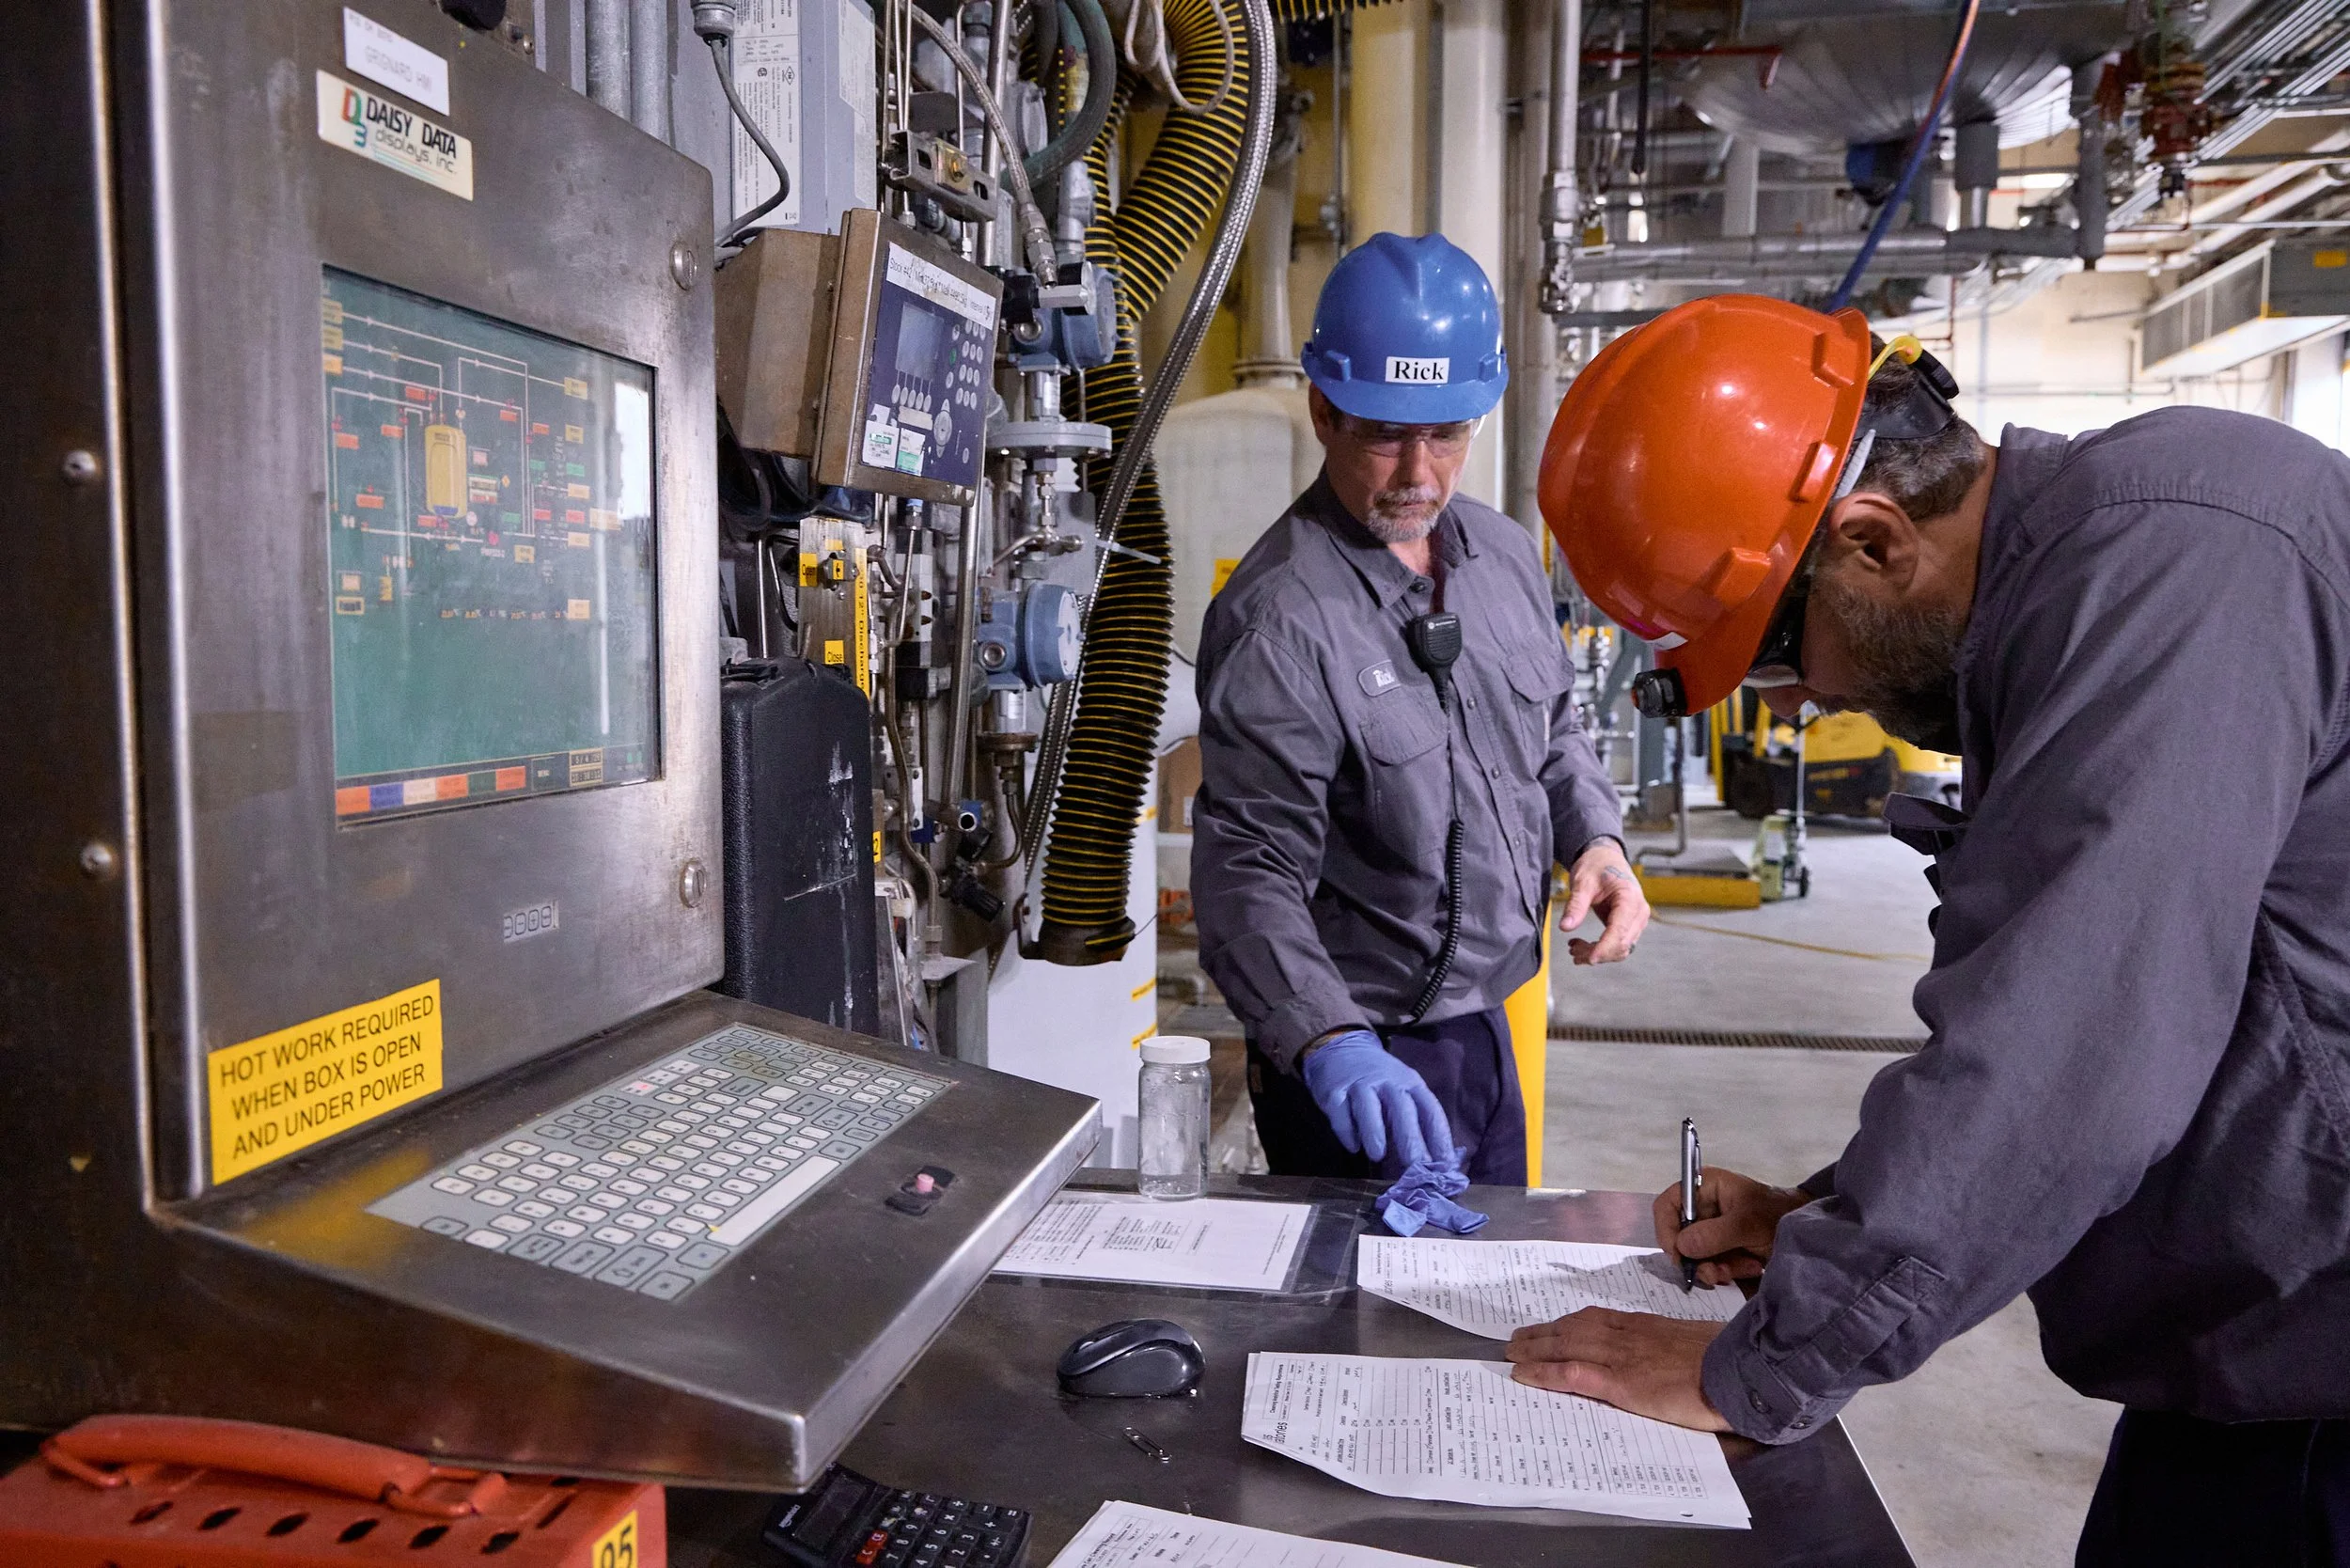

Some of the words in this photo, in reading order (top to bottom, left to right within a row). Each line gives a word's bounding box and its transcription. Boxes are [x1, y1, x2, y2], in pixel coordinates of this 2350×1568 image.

[367, 97, 413, 137] DAISY
[422, 122, 457, 159] DATA
[1394, 360, 1445, 381] Rick
[802, 564, 817, 576] Open
[827, 651, 843, 663] Close
[220, 1051, 267, 1088] HOT
[273, 1027, 337, 1069] WORK
[342, 995, 434, 1045] REQUIRED
[232, 1077, 298, 1121] WHEN
[305, 1059, 346, 1094] BOX
[351, 1051, 368, 1076] IS
[373, 1032, 421, 1067] OPEN
[233, 1121, 279, 1160] AND
[285, 1090, 354, 1137] UNDER
[360, 1063, 426, 1107] POWER
